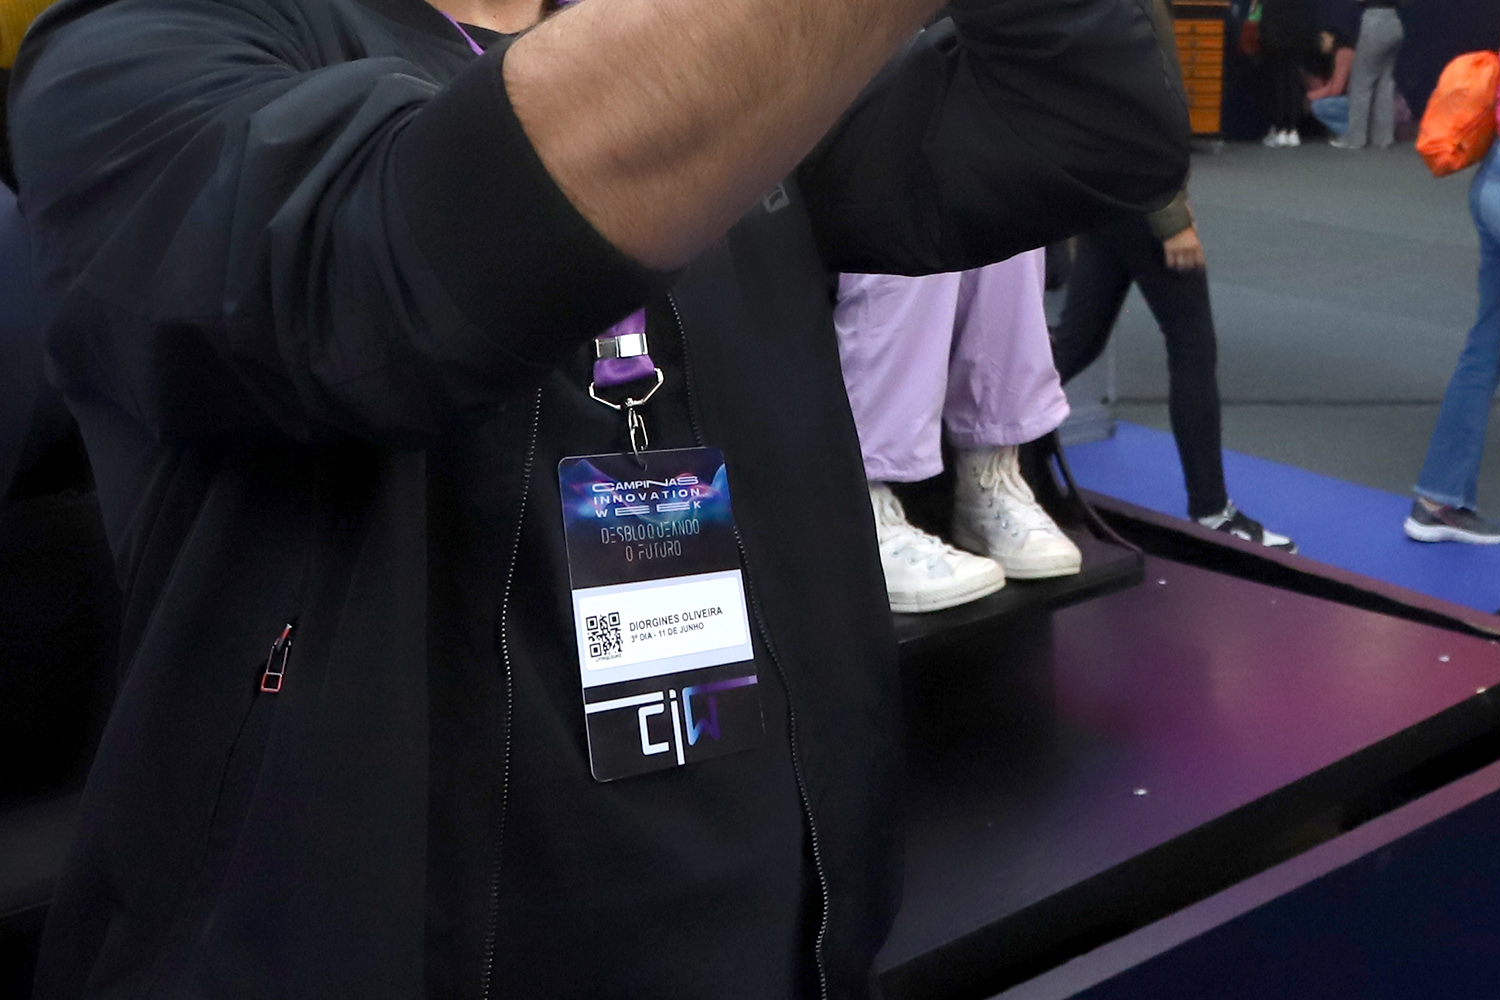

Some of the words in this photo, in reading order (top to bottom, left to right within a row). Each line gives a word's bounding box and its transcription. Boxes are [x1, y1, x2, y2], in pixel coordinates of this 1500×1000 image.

[591, 475, 699, 493] CAMPINAS
[593, 487, 701, 505] INNOVATION
[595, 500, 701, 518] WEEK
[600, 518, 700, 544] DESBLOQUEANDO
[625, 545, 634, 562] O
[638, 540, 682, 561] FUTURO
[629, 614, 680, 633] DIORGINES
[682, 606, 723, 623] OLIVEIRA
[639, 631, 653, 642] DIA
[658, 629, 666, 638] 11
[667, 626, 678, 636] DE
[680, 622, 704, 634] JUNHO
